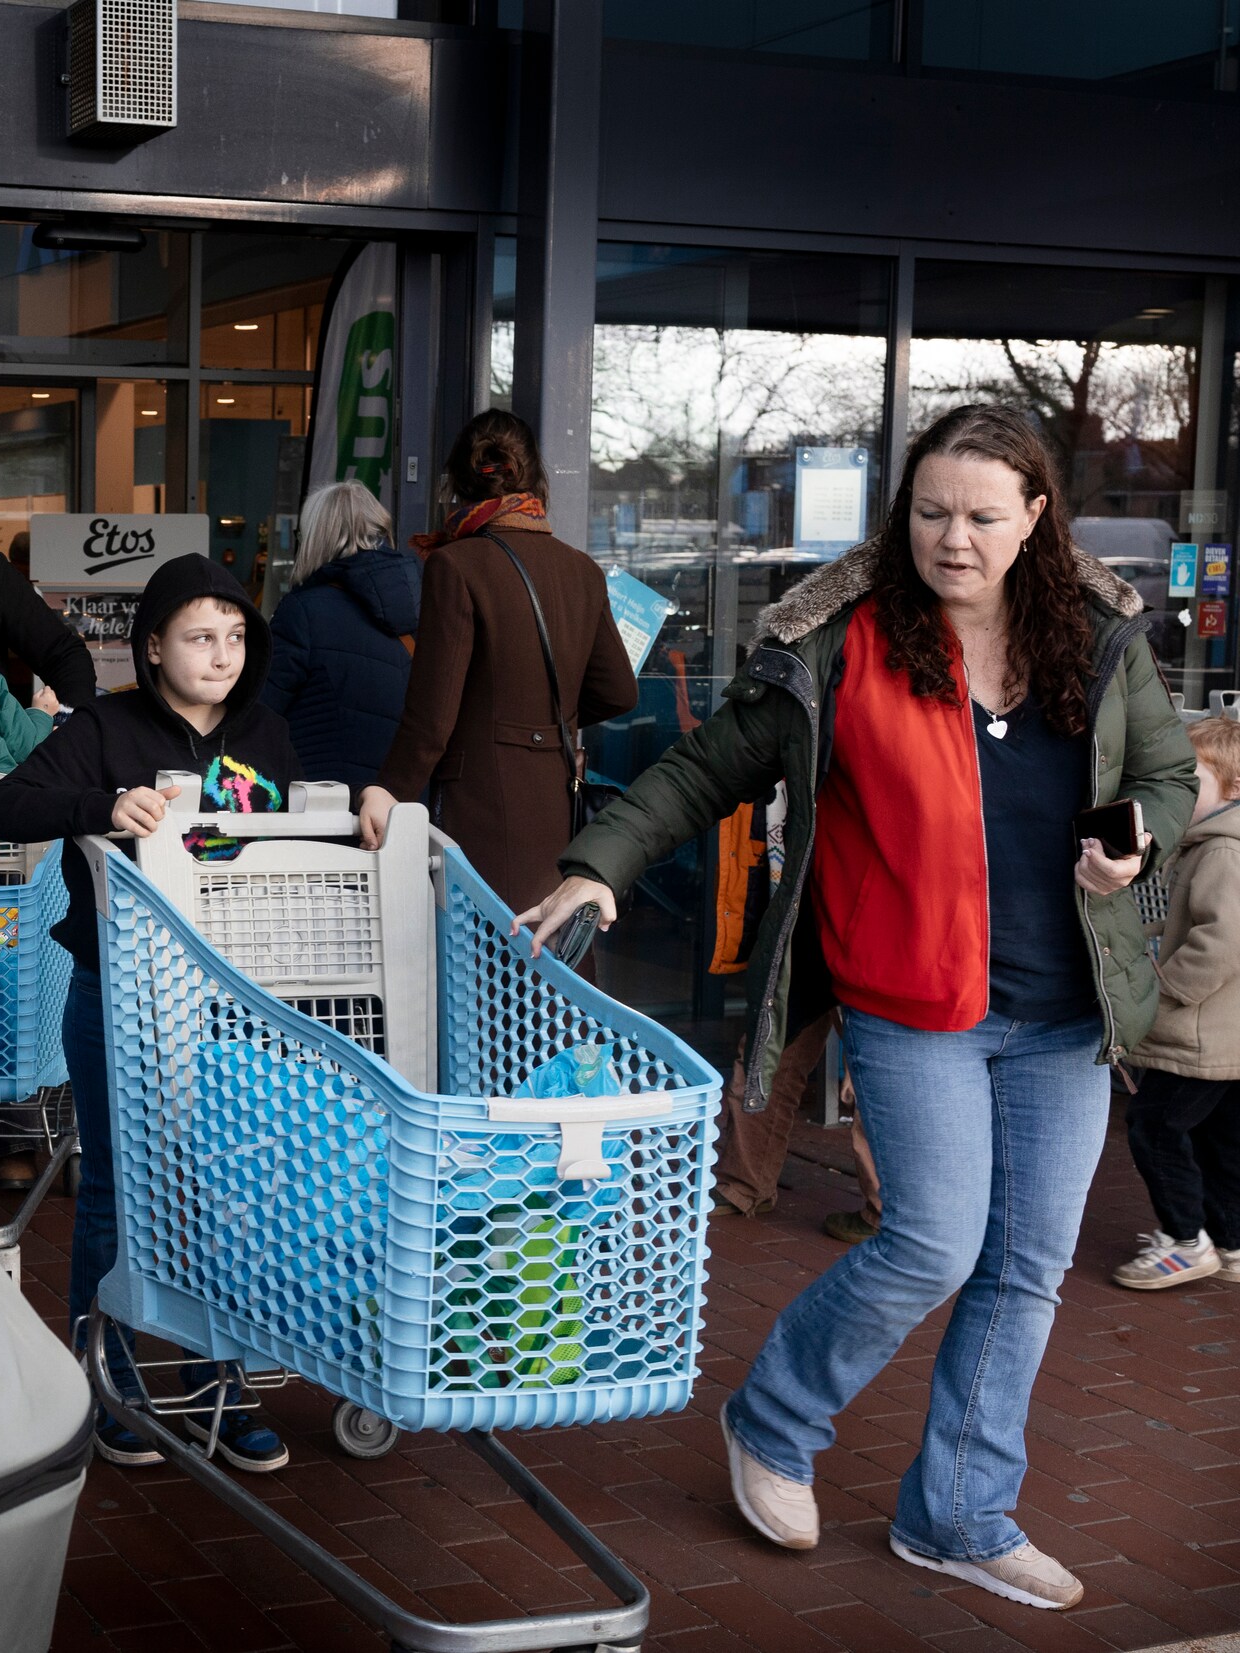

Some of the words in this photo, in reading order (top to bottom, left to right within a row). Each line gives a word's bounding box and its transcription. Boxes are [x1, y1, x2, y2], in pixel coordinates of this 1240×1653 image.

[83, 518, 155, 558] Etos
[66, 597, 118, 614] Klaar
[88, 618, 123, 634] hele
